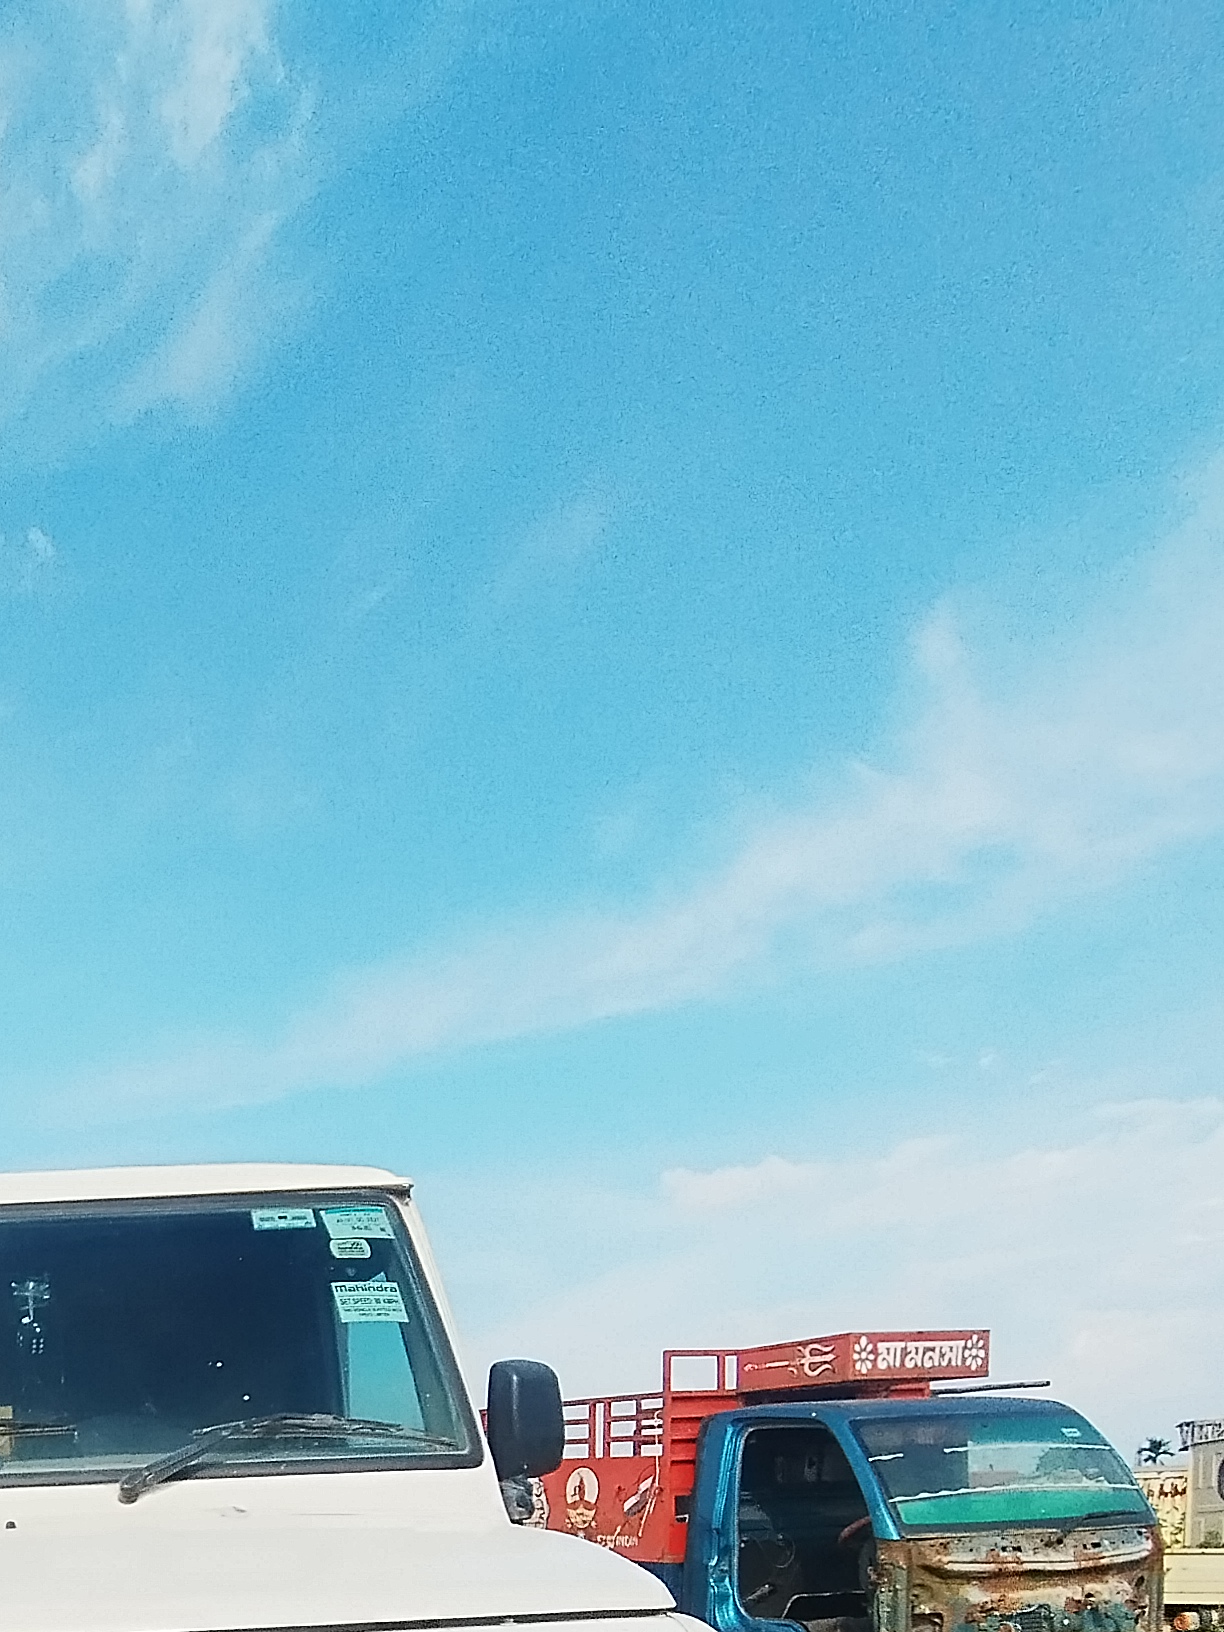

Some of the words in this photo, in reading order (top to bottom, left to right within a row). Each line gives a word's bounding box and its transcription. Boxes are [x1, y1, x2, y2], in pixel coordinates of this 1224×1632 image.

[334, 1284, 398, 1293] Mahindra
[876, 1341, 904, 1369] মা
[905, 1340, 966, 1368] মনসা
